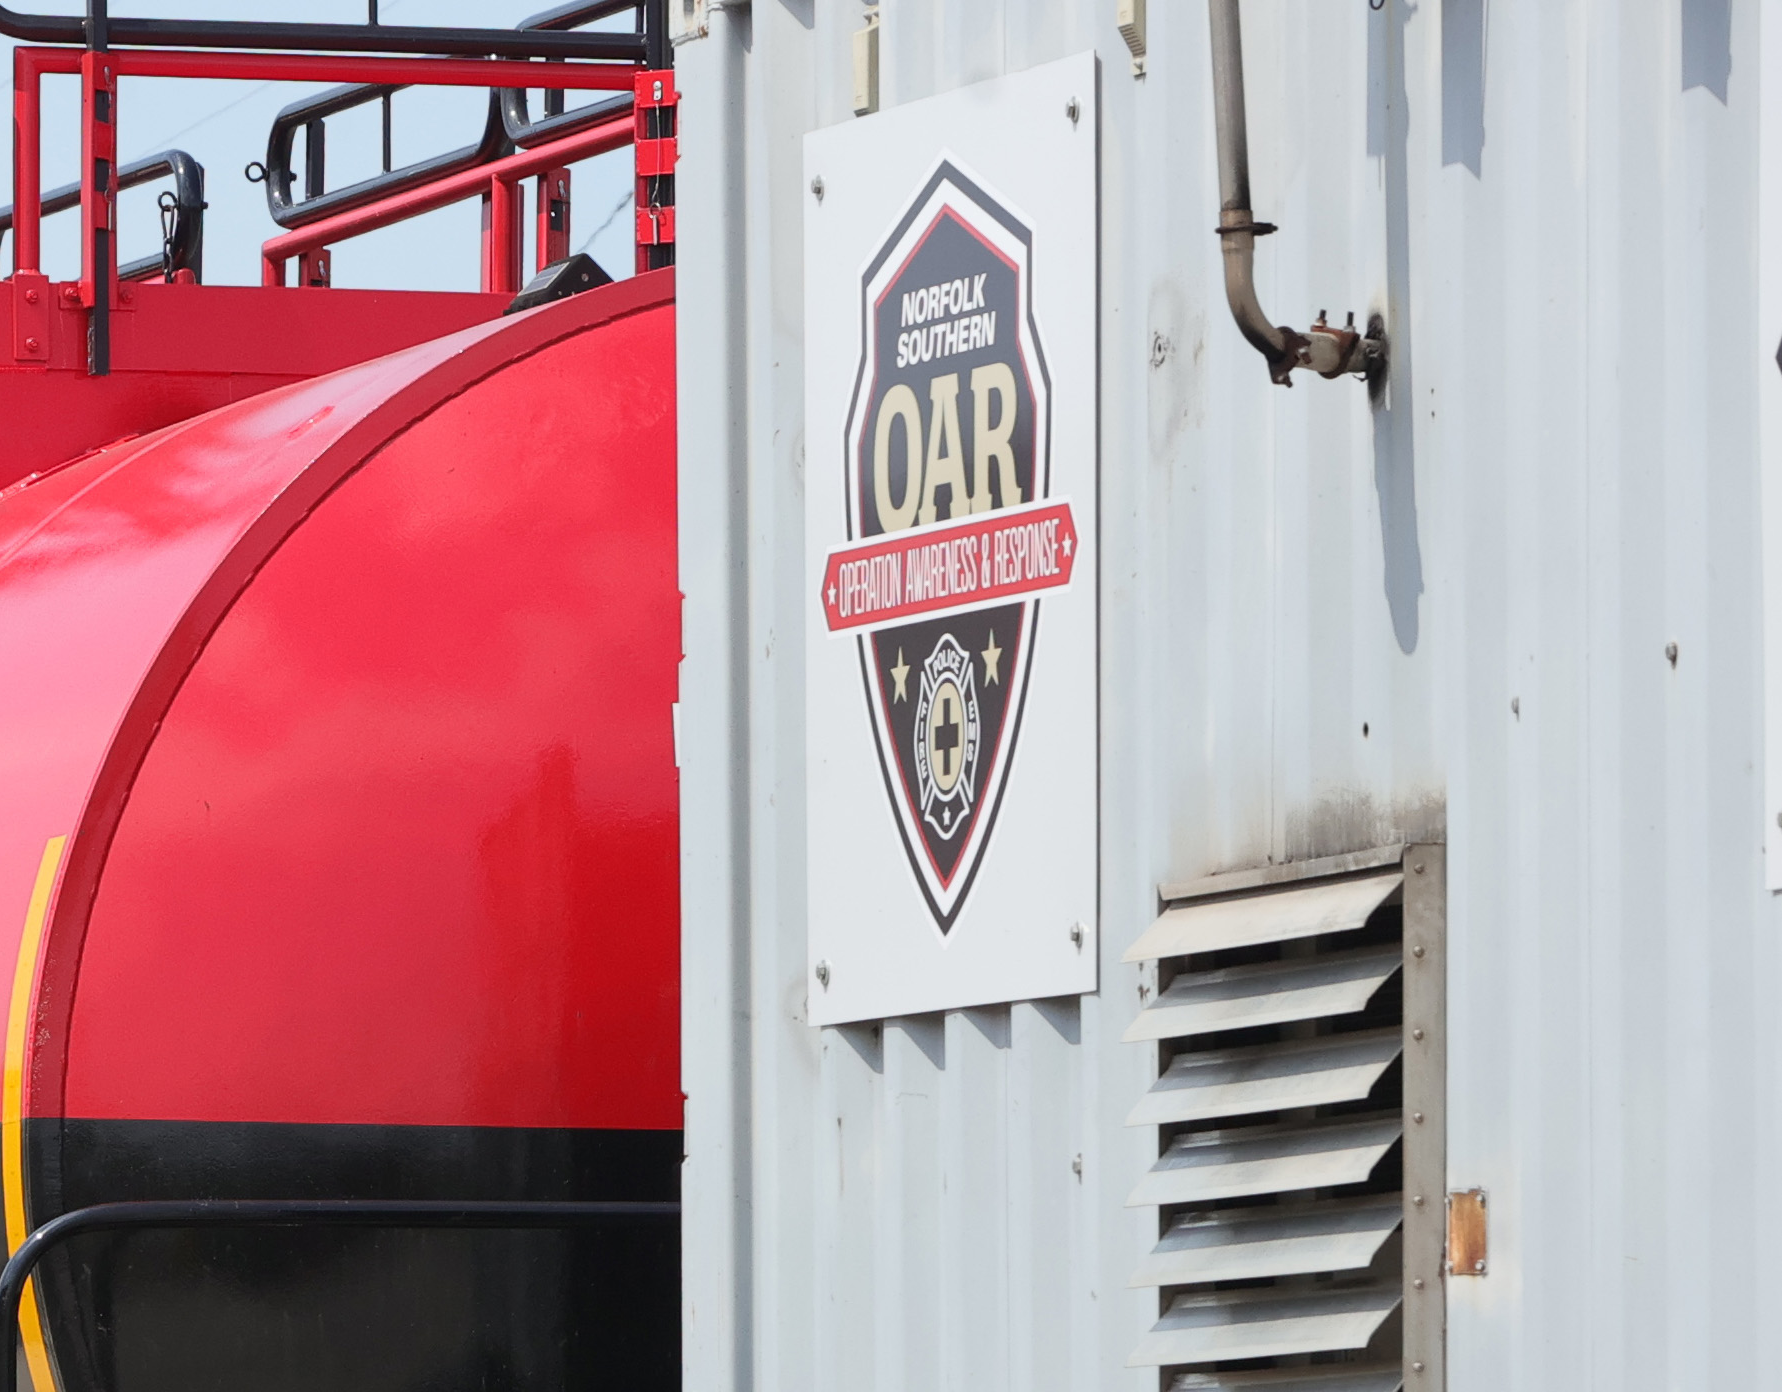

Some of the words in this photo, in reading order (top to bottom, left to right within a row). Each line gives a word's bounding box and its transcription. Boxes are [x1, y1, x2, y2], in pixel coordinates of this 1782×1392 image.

[901, 272, 987, 327] NORFOLK
[896, 311, 997, 368] SOUTHERN
[873, 362, 1024, 535] OAR
[839, 551, 902, 618] OPERATION
[905, 536, 978, 603] AWARENESS
[980, 531, 992, 590] &
[994, 518, 1061, 586] RESPONSE
[932, 648, 962, 679] POLICE
